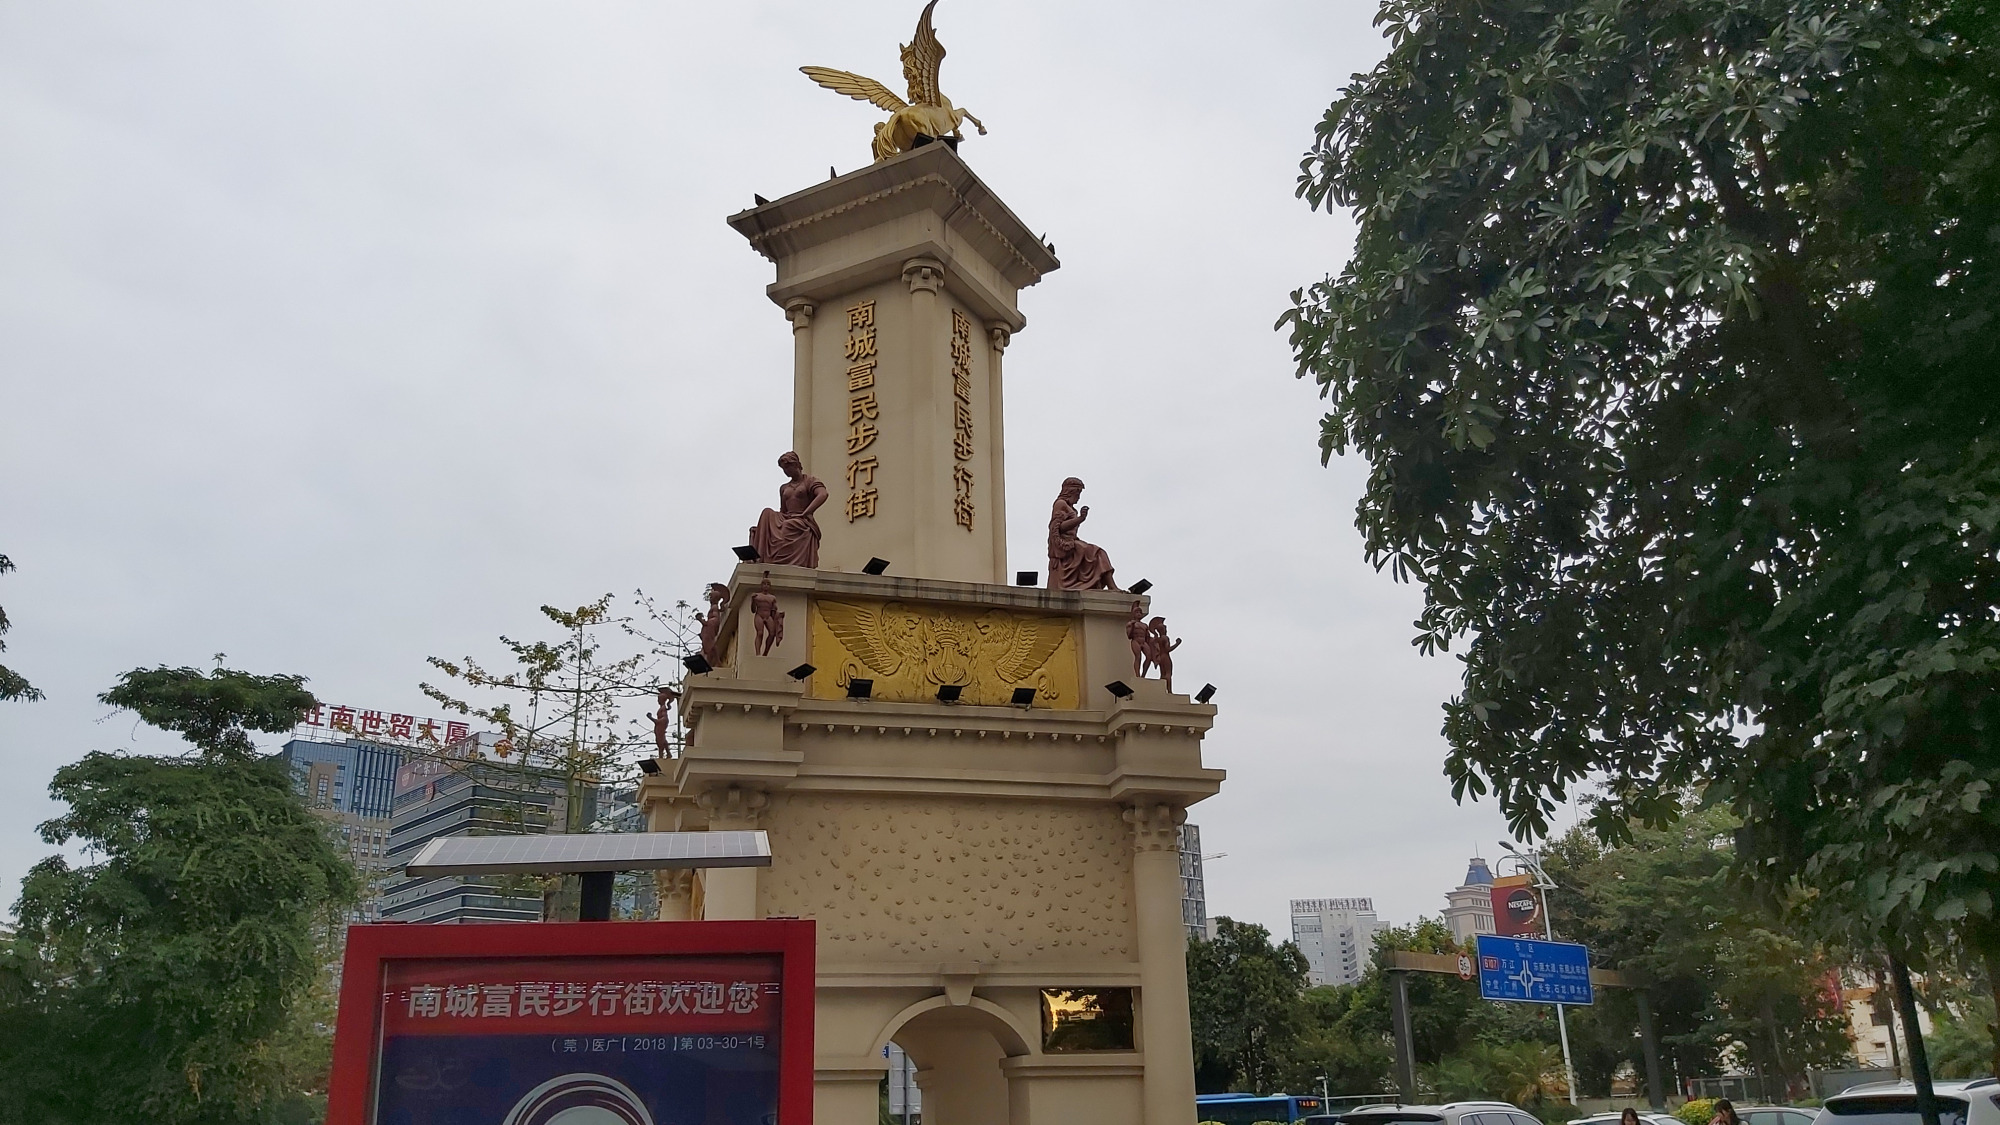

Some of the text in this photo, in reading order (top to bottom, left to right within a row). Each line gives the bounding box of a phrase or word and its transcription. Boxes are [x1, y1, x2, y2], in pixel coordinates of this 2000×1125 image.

[844, 299, 879, 523] 南城富民步行街
[951, 308, 976, 532] 南城富民步行街
[1484, 958, 1497, 969] G107
[1501, 958, 1515, 969] 万江
[408, 981, 759, 1018] 南城富民步行街欢迎您
